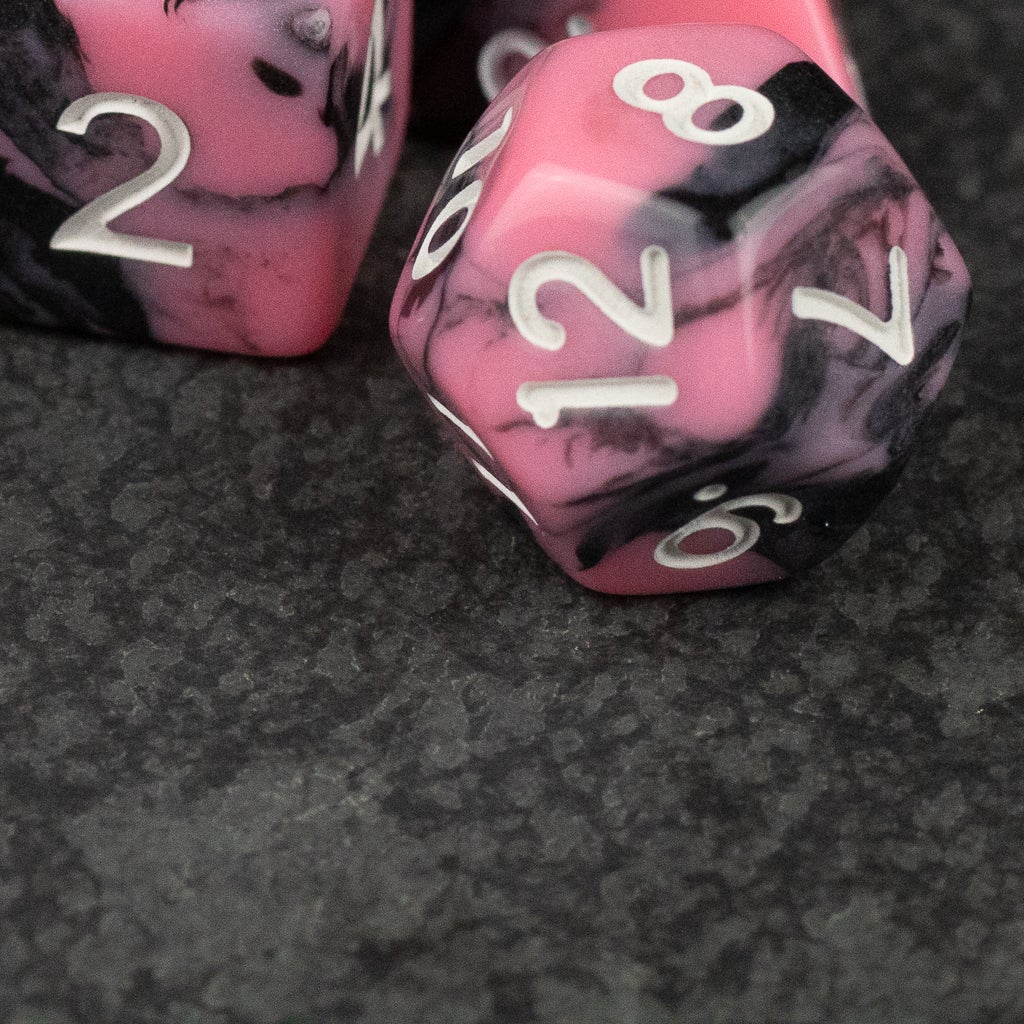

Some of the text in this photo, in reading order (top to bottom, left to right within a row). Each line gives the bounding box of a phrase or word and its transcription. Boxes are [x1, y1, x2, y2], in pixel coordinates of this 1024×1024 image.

[611, 58, 775, 146] 8
[49, 91, 194, 269] 2
[507, 243, 679, 429] 12
[790, 244, 915, 367] 7
